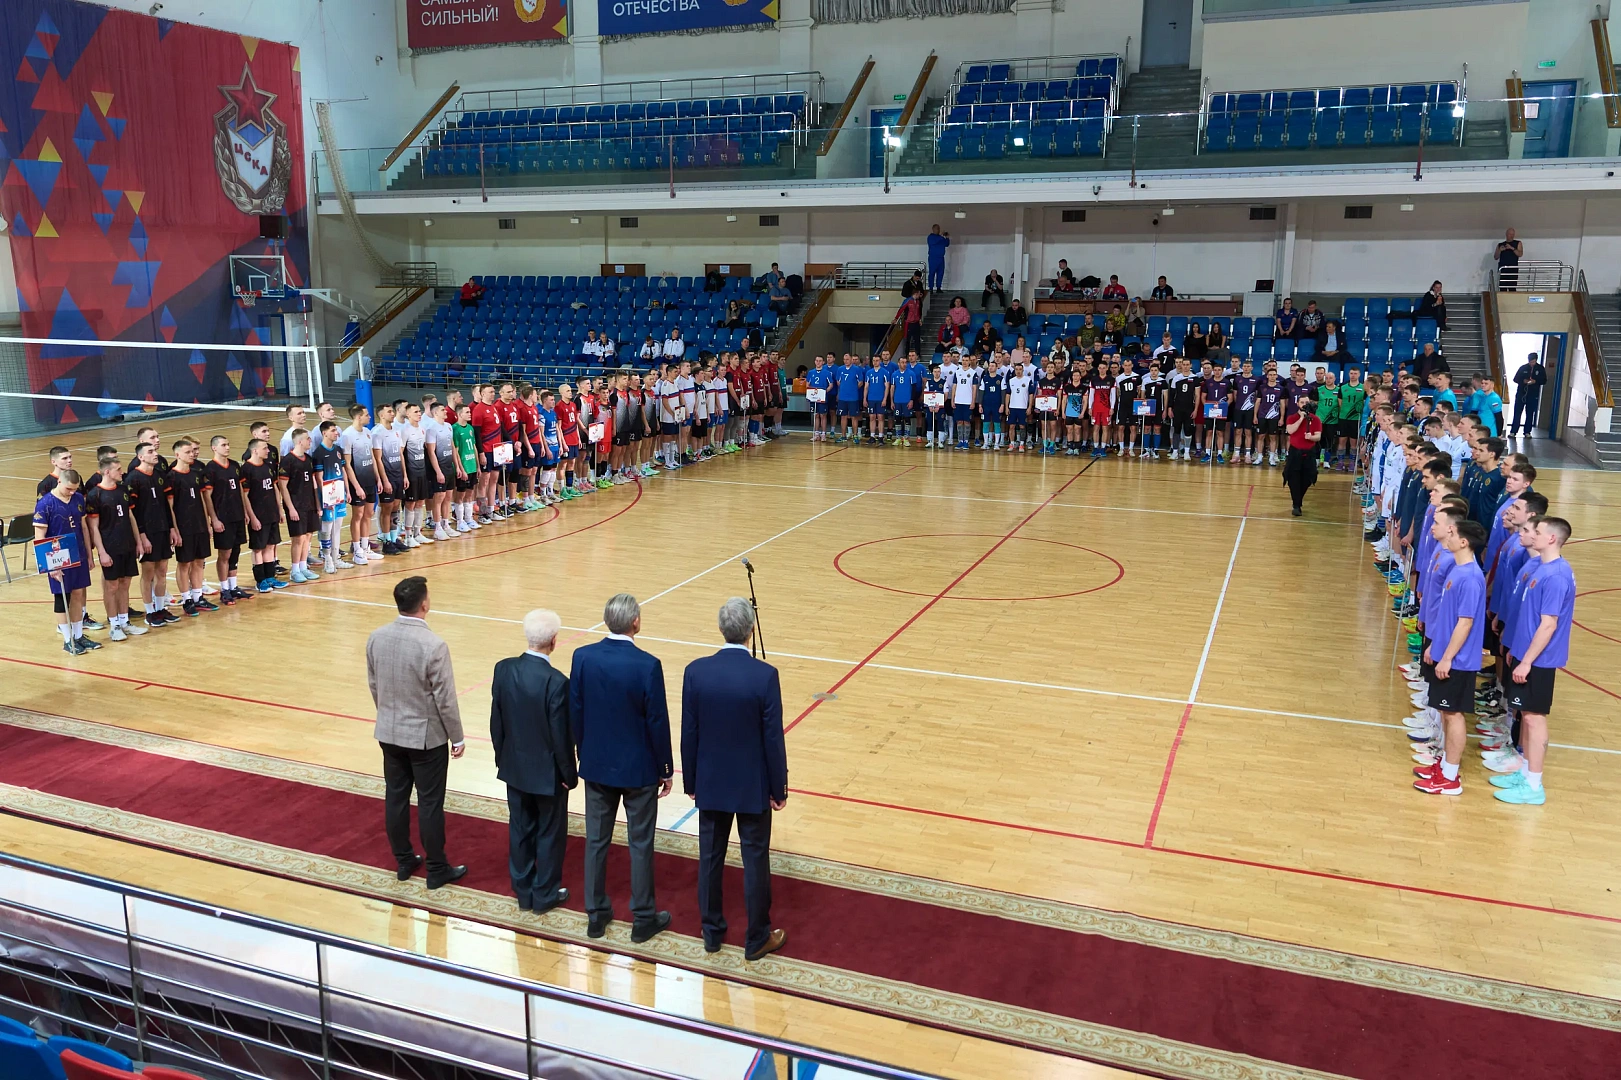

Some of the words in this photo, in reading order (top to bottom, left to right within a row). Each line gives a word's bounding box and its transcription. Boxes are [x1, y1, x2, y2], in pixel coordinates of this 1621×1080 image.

[613, 0, 700, 16] ОТЕЧЕСТВА
[421, 4, 499, 26] СИЛЬНЫЙ!
[234, 143, 268, 175] ЦСКА
[1266, 394, 1276, 403] 19
[509, 411, 518, 423] 12
[568, 412, 576, 423] 19
[465, 438, 474, 451] 11
[334, 462, 341, 476] 3
[304, 471, 310, 482] 5
[262, 478, 274, 490] 42
[150, 487, 157, 498] 1
[189, 487, 196, 499] 4
[116, 504, 124, 517] 3
[68, 515, 76, 528] 2
